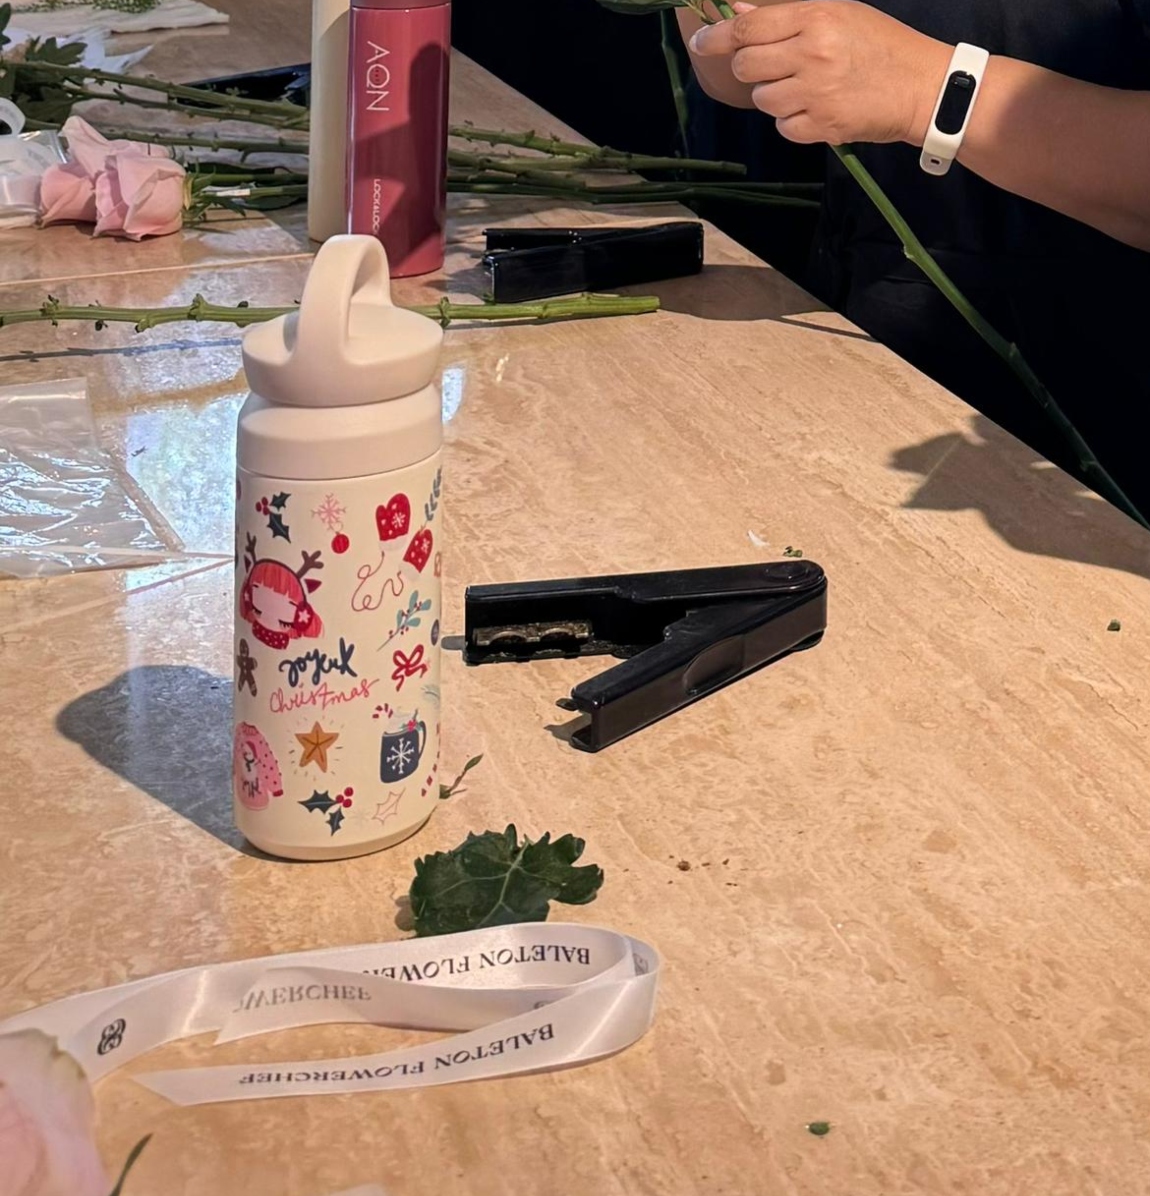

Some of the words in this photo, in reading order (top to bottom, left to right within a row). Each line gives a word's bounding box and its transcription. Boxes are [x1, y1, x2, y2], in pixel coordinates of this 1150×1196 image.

[478, 944, 590, 969] BALETON
[434, 1023, 554, 1069] BALETON
[238, 1061, 425, 1084] FLOWERCHEF
